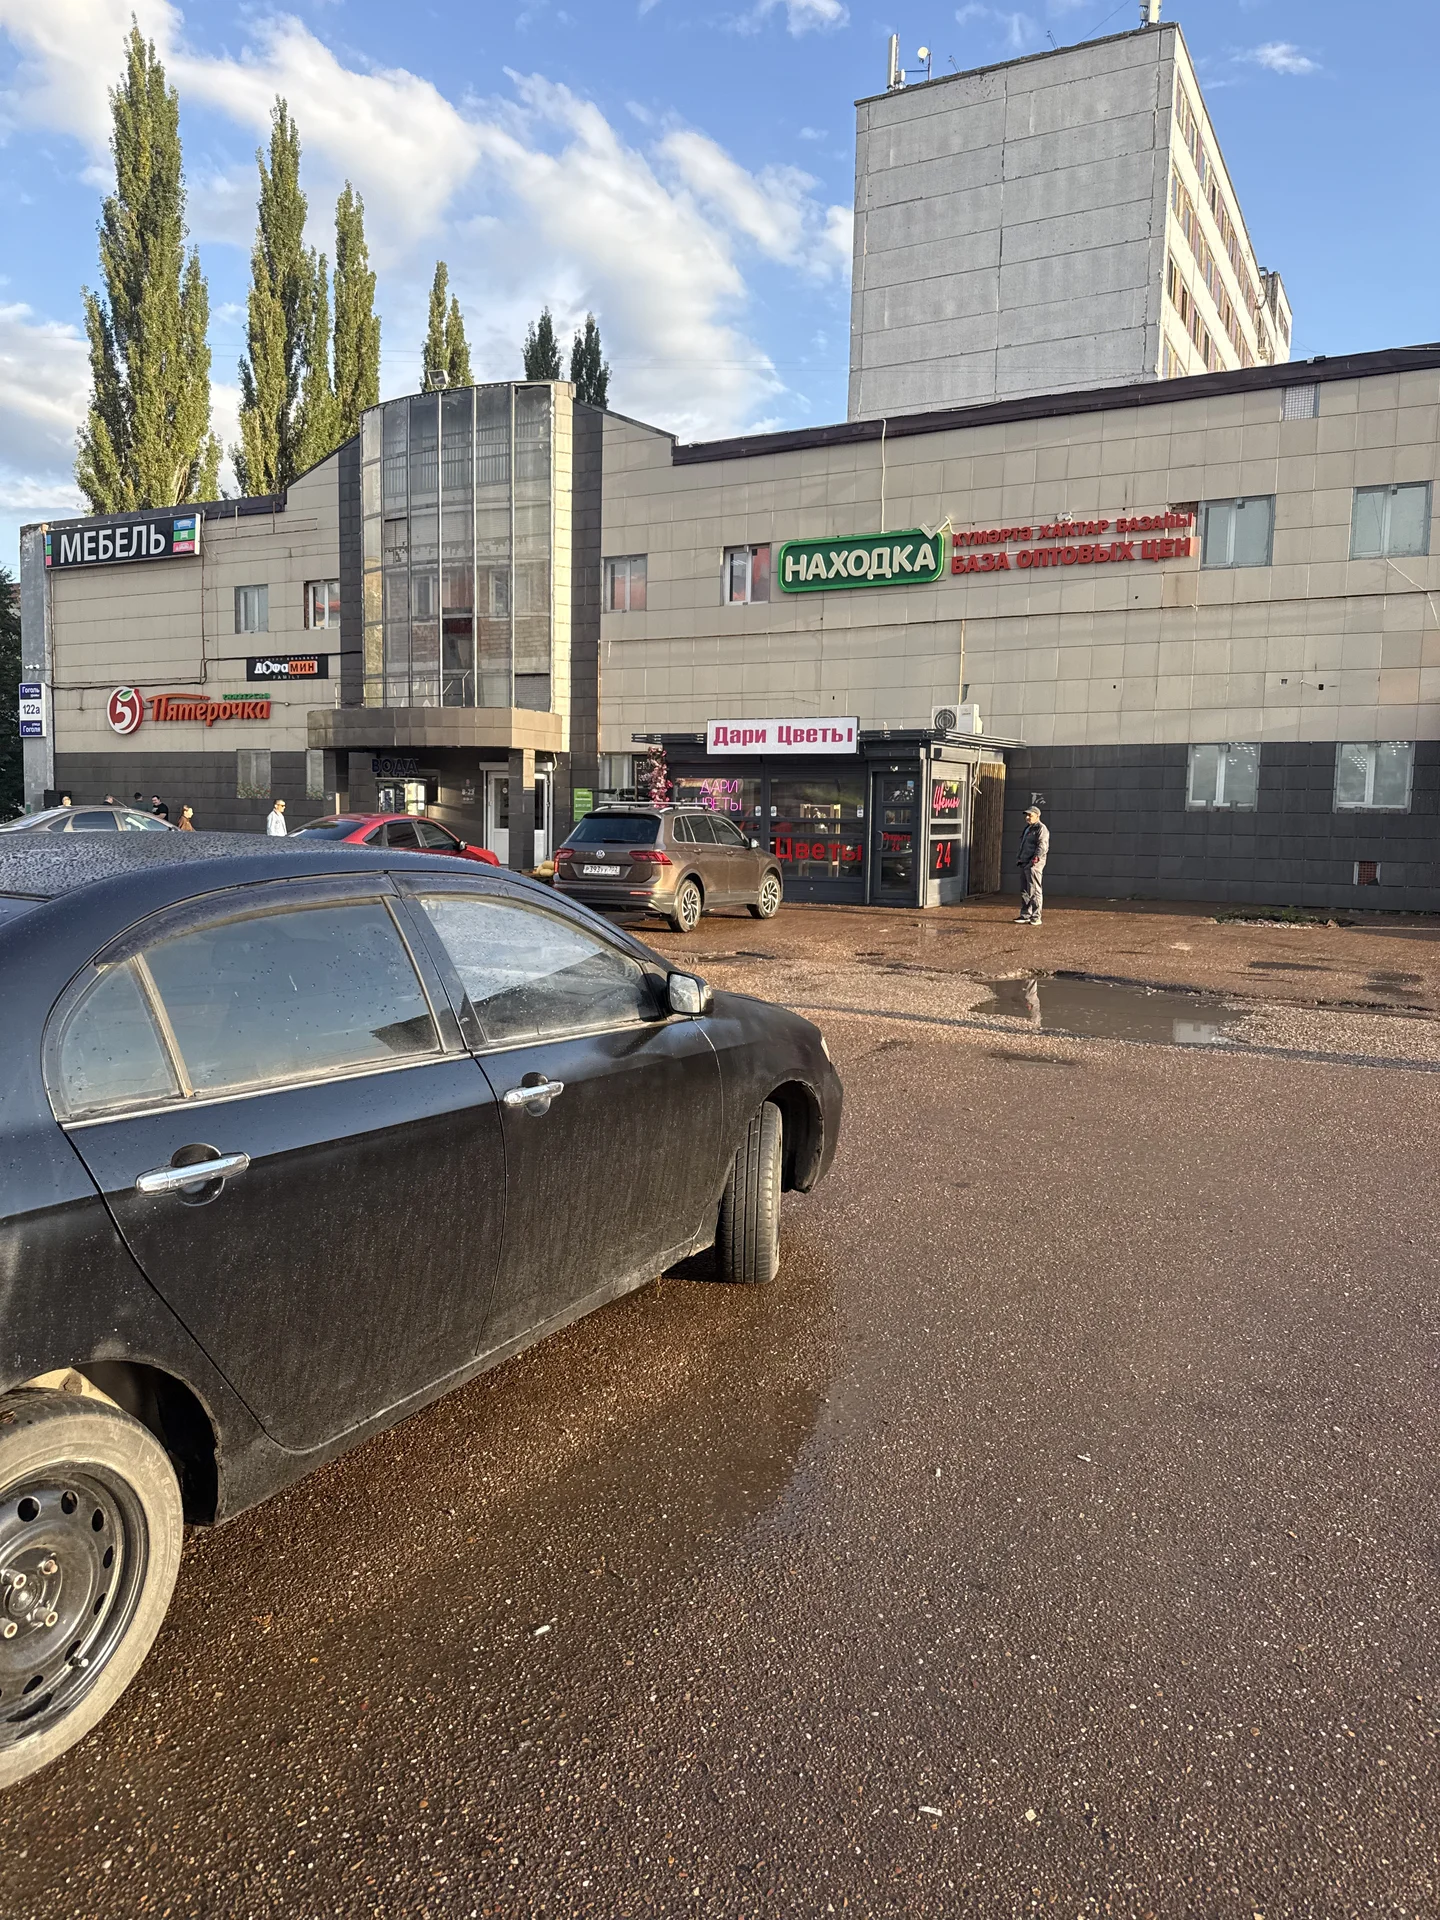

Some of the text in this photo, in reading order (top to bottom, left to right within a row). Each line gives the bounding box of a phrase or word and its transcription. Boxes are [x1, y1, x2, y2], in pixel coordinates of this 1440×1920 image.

[60, 523, 166, 564] МЕБЕЛЬ
[951, 537, 1191, 575] БАЗА ОПТОВЫХ ЦЕН
[785, 542, 937, 582] НАХОДКА
[146, 693, 271, 727] Пятерочка
[713, 724, 854, 747] Дари Цветы
[371, 758, 419, 777] ВОДА
[699, 778, 738, 795] ДАРИ
[775, 837, 862, 863] Цветы
[891, 843, 901, 852] 24
[936, 841, 951, 869] 24
